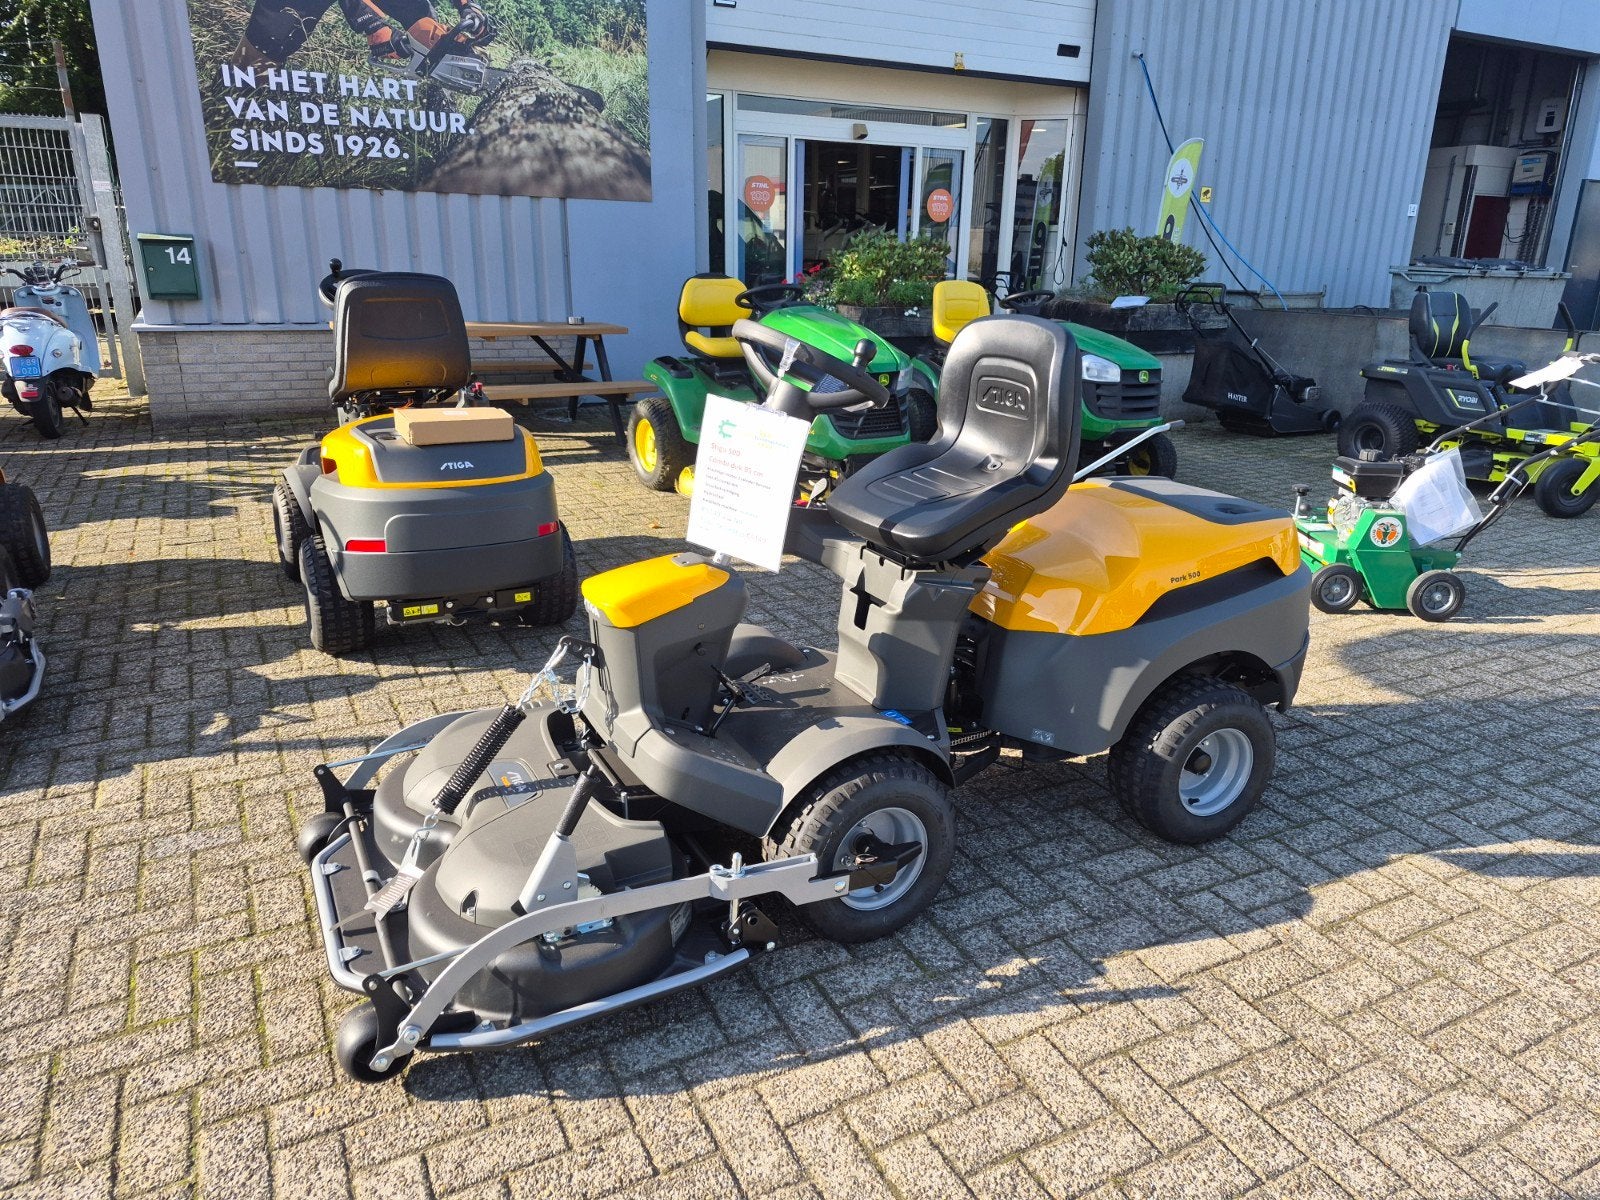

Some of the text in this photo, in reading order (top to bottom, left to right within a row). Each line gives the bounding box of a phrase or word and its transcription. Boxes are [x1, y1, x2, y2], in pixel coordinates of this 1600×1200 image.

[221, 64, 417, 101] IN HET HART
[224, 96, 475, 135] VAN DE NATUUR.
[230, 128, 410, 160] SINDS 1926.
[164, 246, 192, 265] 14
[981, 386, 1026, 411] STIGA
[1227, 392, 1248, 403] HAYTER
[1458, 395, 1478, 404] RYOBI
[440, 461, 475, 471] STIGA
[1170, 570, 1201, 584] Park 500
